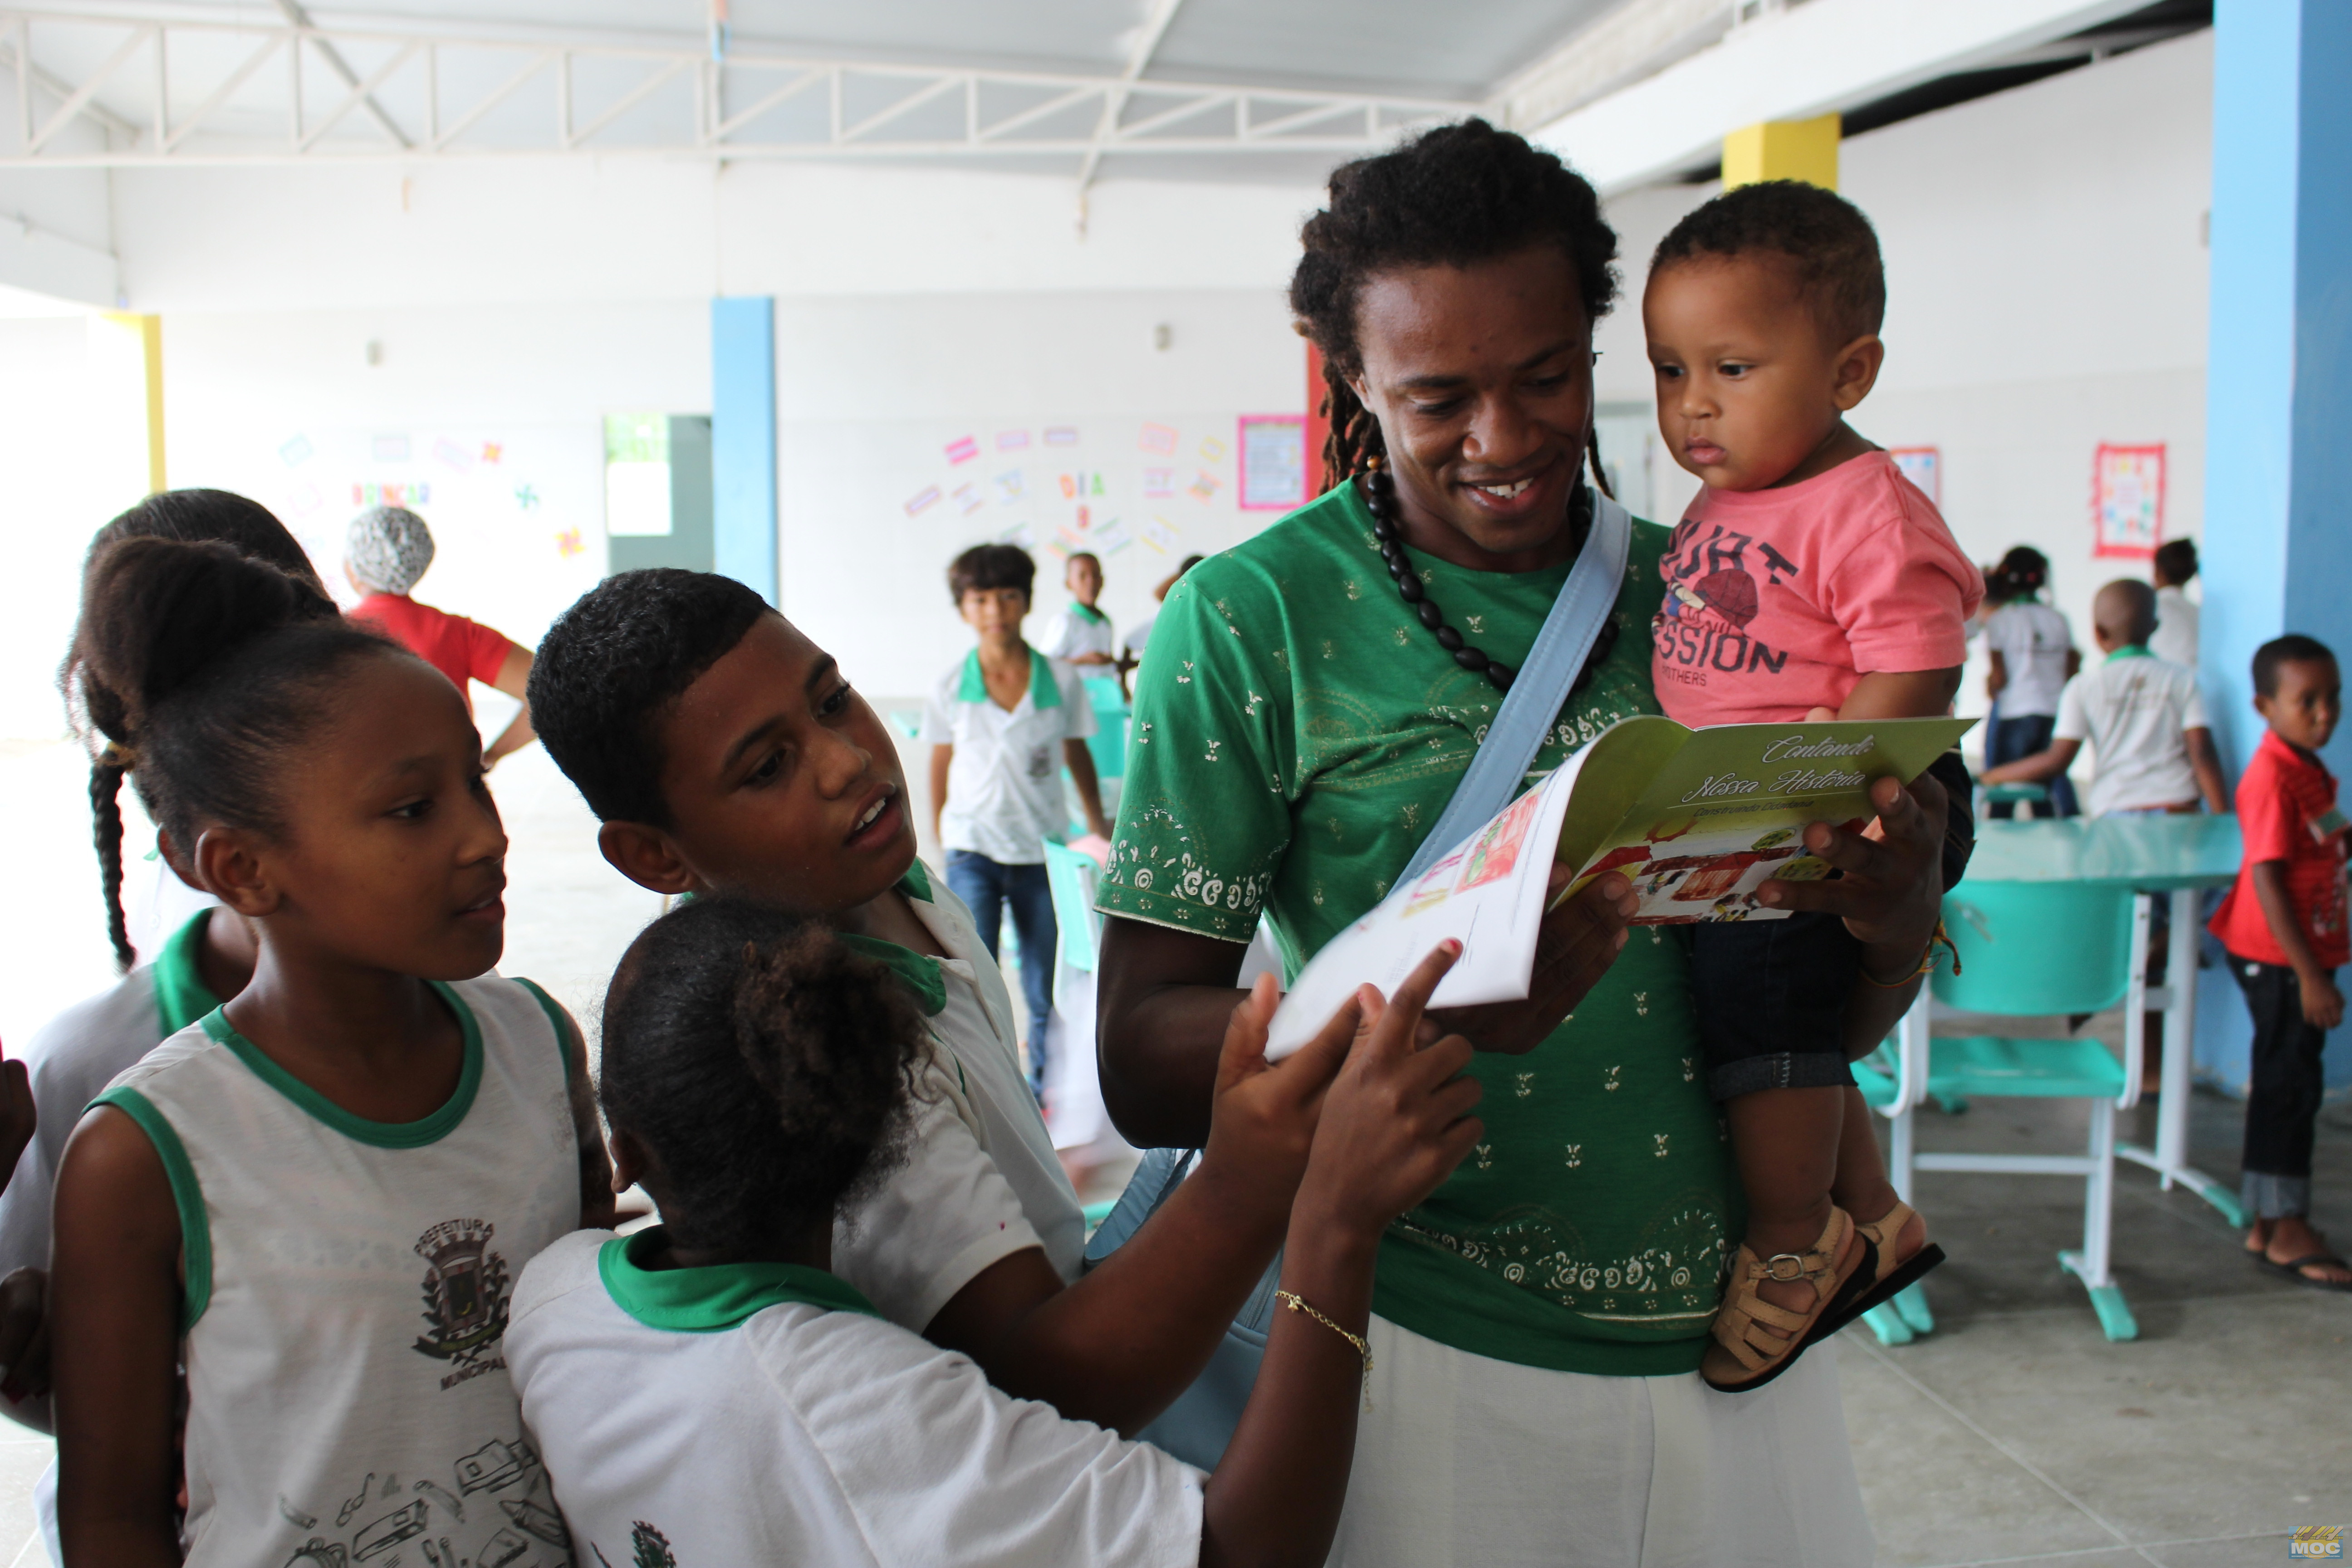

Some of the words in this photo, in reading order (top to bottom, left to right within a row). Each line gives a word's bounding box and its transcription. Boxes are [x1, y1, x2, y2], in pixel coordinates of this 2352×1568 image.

[1058, 471, 1106, 500] DIA
[1653, 621, 1788, 674] SSION
[1762, 734, 1874, 763] Contando
[1681, 772, 1761, 803] Nossa
[1694, 804, 1760, 817] Construindo
[414, 1218, 494, 1255] PREFEITURA
